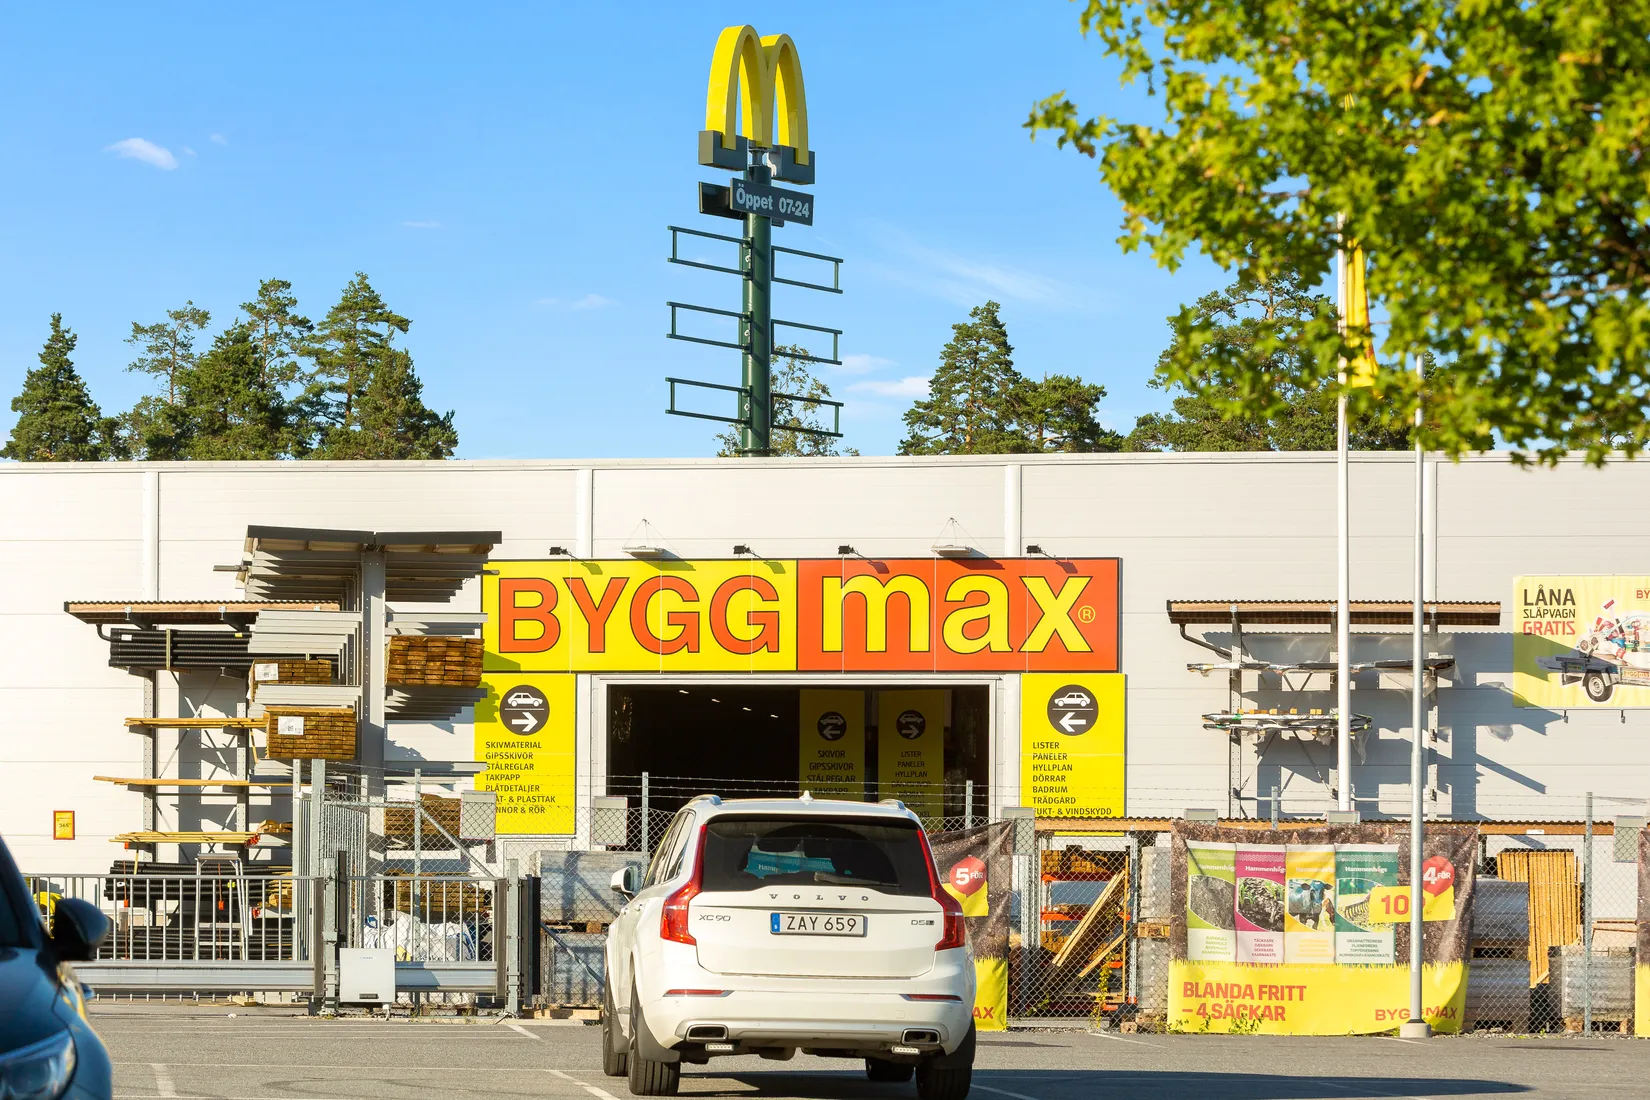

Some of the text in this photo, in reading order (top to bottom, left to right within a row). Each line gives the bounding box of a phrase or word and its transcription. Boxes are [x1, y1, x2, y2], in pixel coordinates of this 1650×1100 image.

[736, 183, 809, 217] Öppet 07-24
[1524, 584, 1576, 606] LÅNA
[499, 575, 779, 655] BYGG
[1523, 607, 1576, 618] SLÄPVAGN
[1523, 621, 1576, 635] GRATIS
[485, 741, 542, 749] SKIVMATERIAL
[485, 752, 533, 760] GIPSSKIVOR
[818, 750, 845, 758] SKIVOR
[1032, 753, 1067, 761] PANELER
[486, 762, 534, 770] STÅLREGLAR
[809, 762, 854, 771] GIPSSKIVOR
[1032, 774, 1066, 782] DÖRRAR
[485, 783, 540, 793] PLÅTDETALJER
[517, 795, 556, 803] PLASTTAK
[1032, 795, 1076, 804] TRÄDGÅRD
[495, 804, 545, 814] NNOR & RÖR
[955, 868, 984, 885] 5 FÖR
[1423, 866, 1451, 885] 4 FÖR
[786, 916, 819, 931] ZAY
[824, 917, 857, 932] 659
[1183, 981, 1307, 1001] BLANDA FRITT
[1211, 1000, 1286, 1021] SÄCKAR
[1375, 1006, 1458, 1021] BYGMAX
